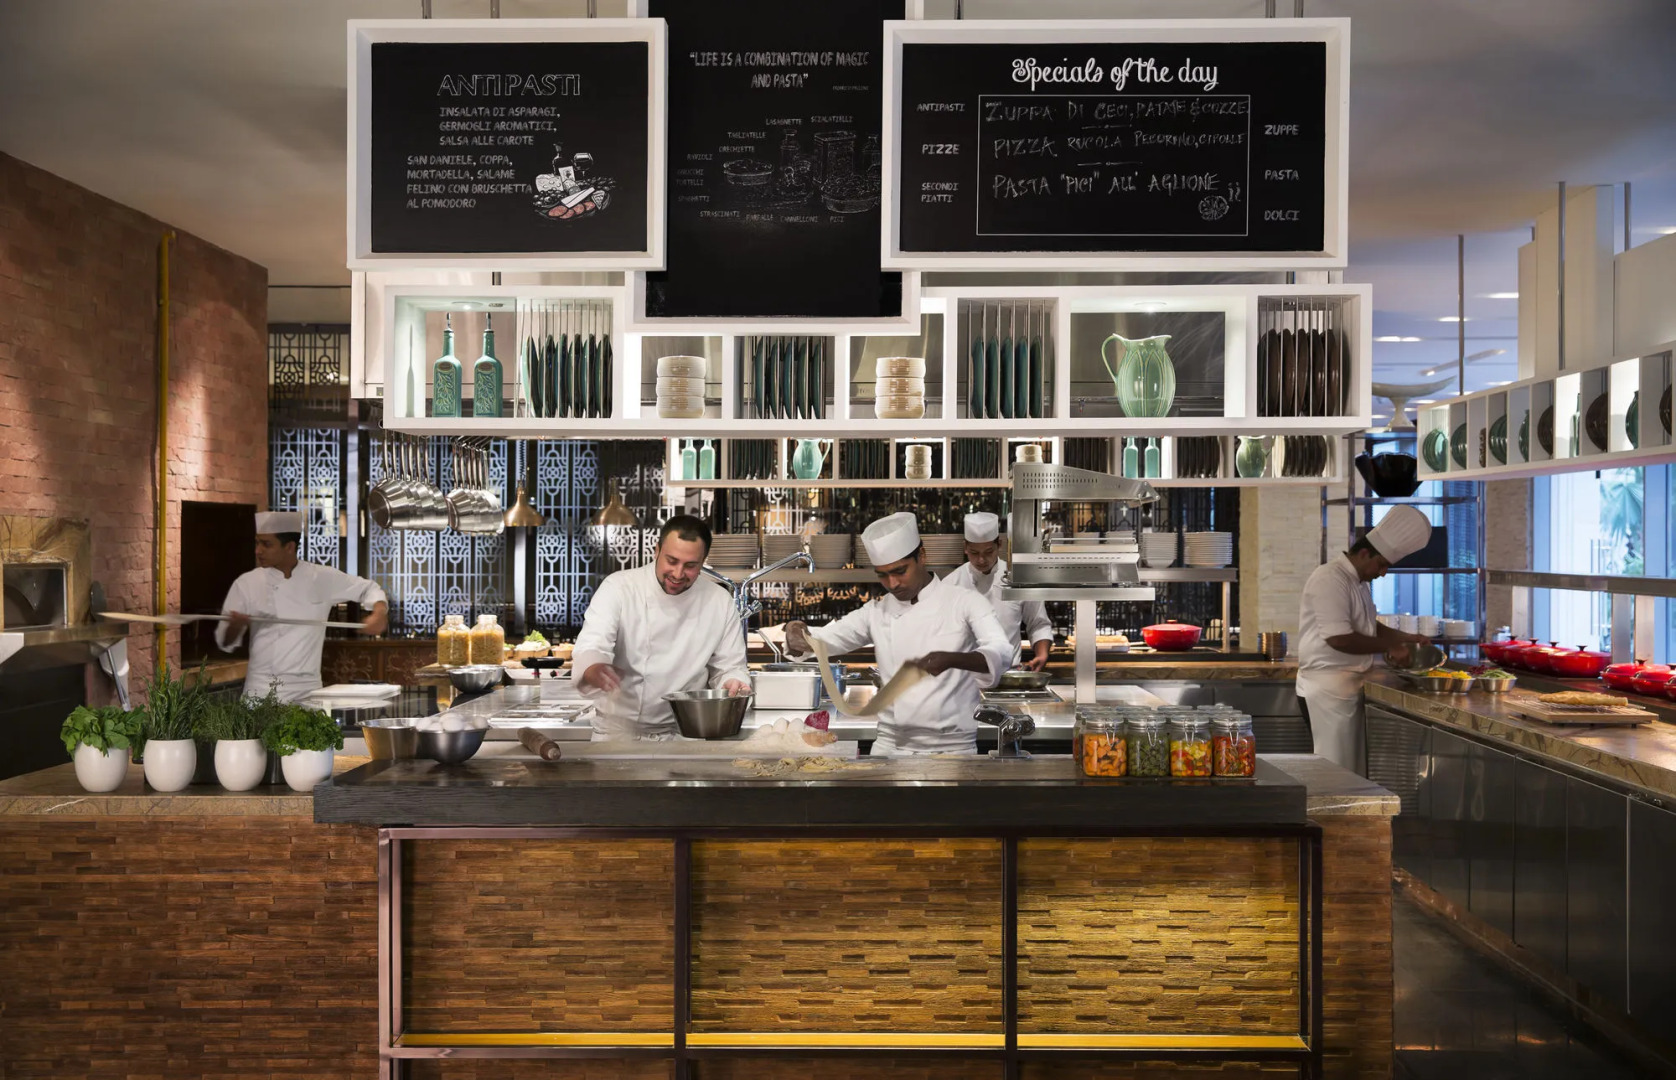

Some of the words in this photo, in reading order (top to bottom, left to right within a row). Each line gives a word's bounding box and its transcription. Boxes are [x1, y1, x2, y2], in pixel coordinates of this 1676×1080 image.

[720, 52, 733, 66] IS
[735, 52, 742, 66] A
[744, 52, 818, 66] COMBINATION
[820, 52, 833, 66] OF
[836, 52, 870, 66] MAGIC
[1012, 57, 1104, 91] Specials
[1110, 57, 1133, 91] of
[1133, 57, 1173, 83] the
[1178, 57, 1219, 91] day
[437, 74, 580, 96] ANTIPASTI
[751, 73, 771, 88] AND
[439, 107, 490, 117] INSALATA
[493, 107, 504, 117] DI
[508, 107, 561, 118] ASPARAGI,
[916, 103, 965, 112] ANTIPASTI
[1068, 101, 1084, 120] DI
[439, 121, 491, 131] GERMOGLI
[494, 121, 557, 132] AROMATICI,
[1264, 124, 1299, 135] ZUPPE
[439, 136, 468, 146] SALSA
[471, 136, 495, 146] ALLE
[498, 136, 534, 146] CAROTE
[921, 144, 960, 155] PIZZE
[994, 136, 1058, 159] PIZZA
[407, 155, 428, 165] SAN
[430, 155, 476, 167] DANIELE,
[480, 155, 513, 167] COPPA,
[407, 170, 474, 181] MORTADELLA,
[477, 170, 515, 180] SALAME
[1264, 169, 1299, 180] PASTA
[407, 184, 445, 194] FELINO
[448, 184, 469, 194] CON
[472, 184, 532, 194] BRUSCHETTA
[921, 182, 959, 191] SECONDI
[992, 174, 1052, 199] PASTA
[1148, 172, 1220, 197] AGLIONE
[406, 198, 419, 208] AL
[421, 198, 476, 208] POMODORO
[921, 194, 953, 203] PIATTI
[1264, 210, 1300, 220] DOLCI
